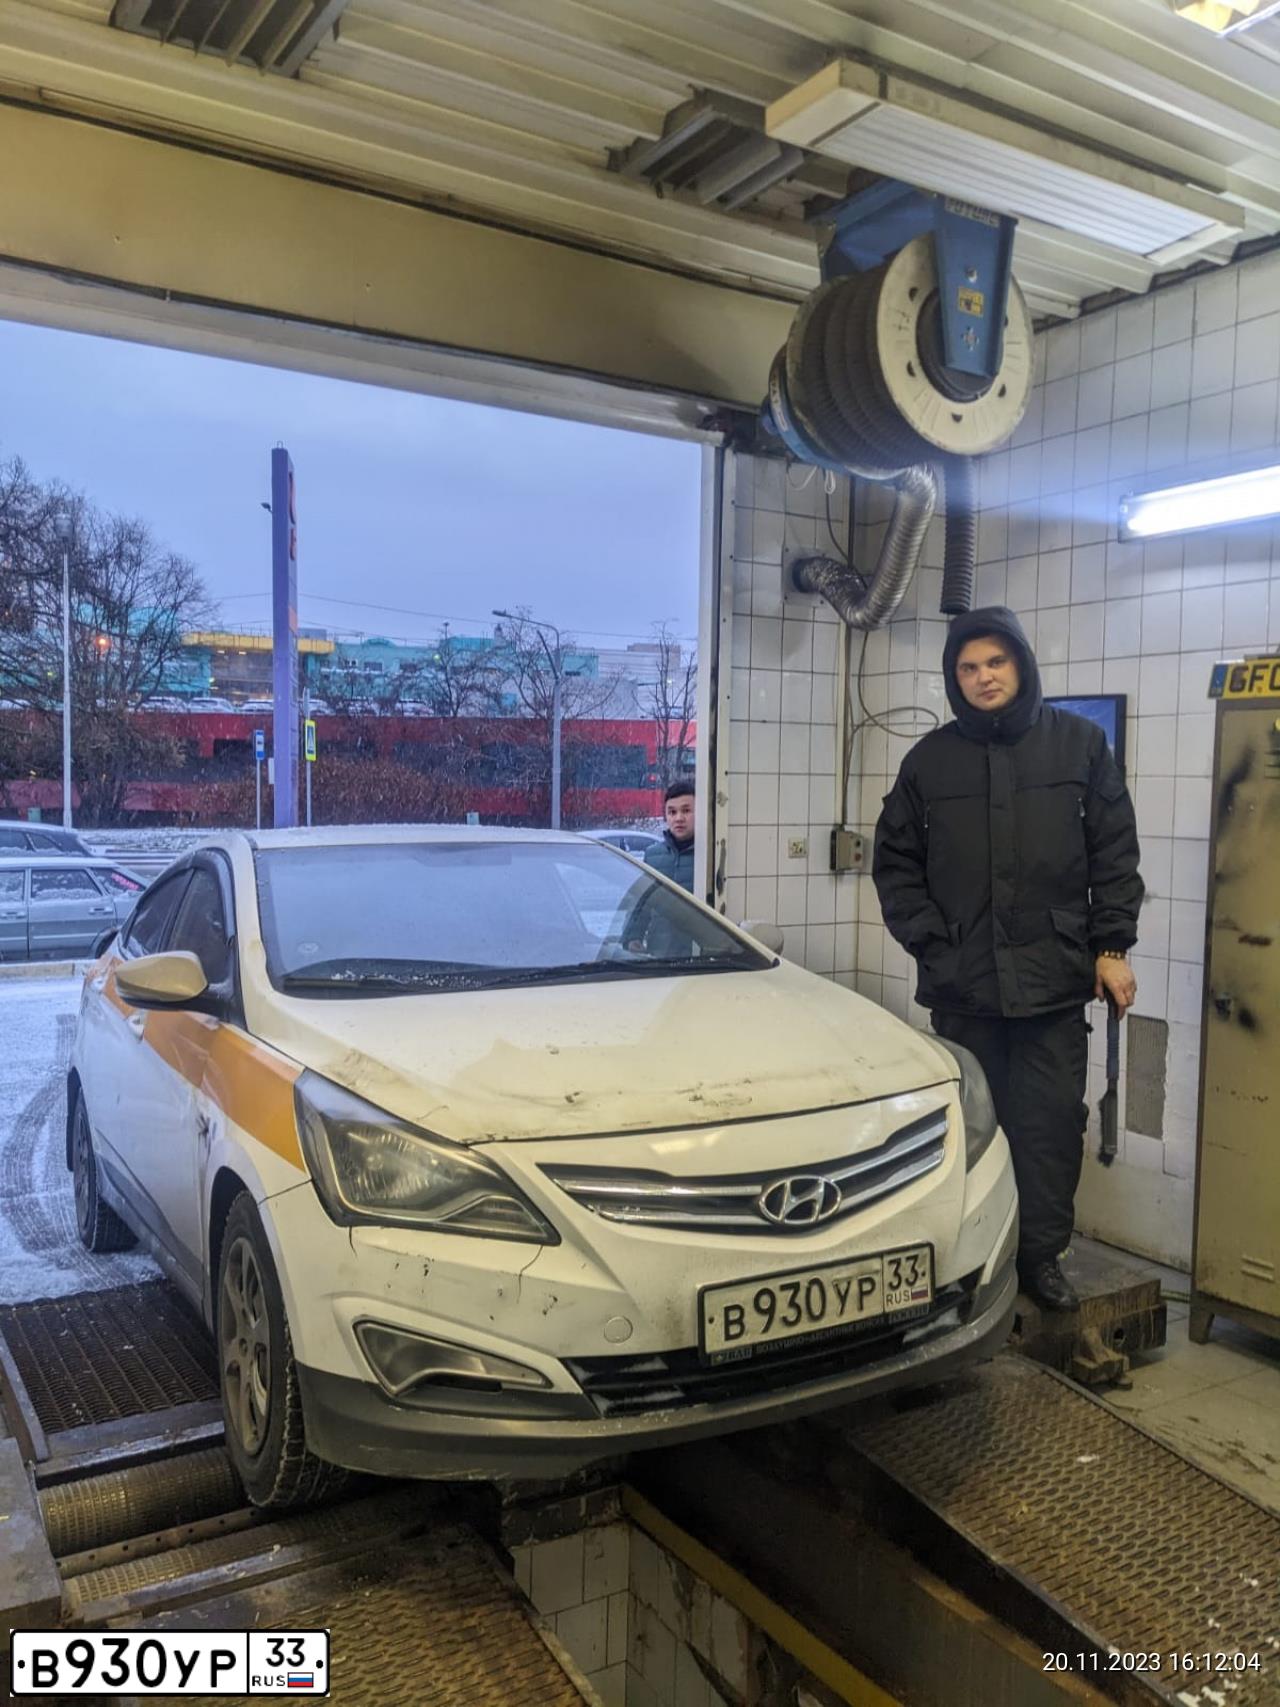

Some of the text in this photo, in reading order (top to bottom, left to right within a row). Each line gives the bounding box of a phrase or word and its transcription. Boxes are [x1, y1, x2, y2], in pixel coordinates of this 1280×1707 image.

[723, 1254, 920, 1342] В930УР 33
[886, 1290, 910, 1306] RUS
